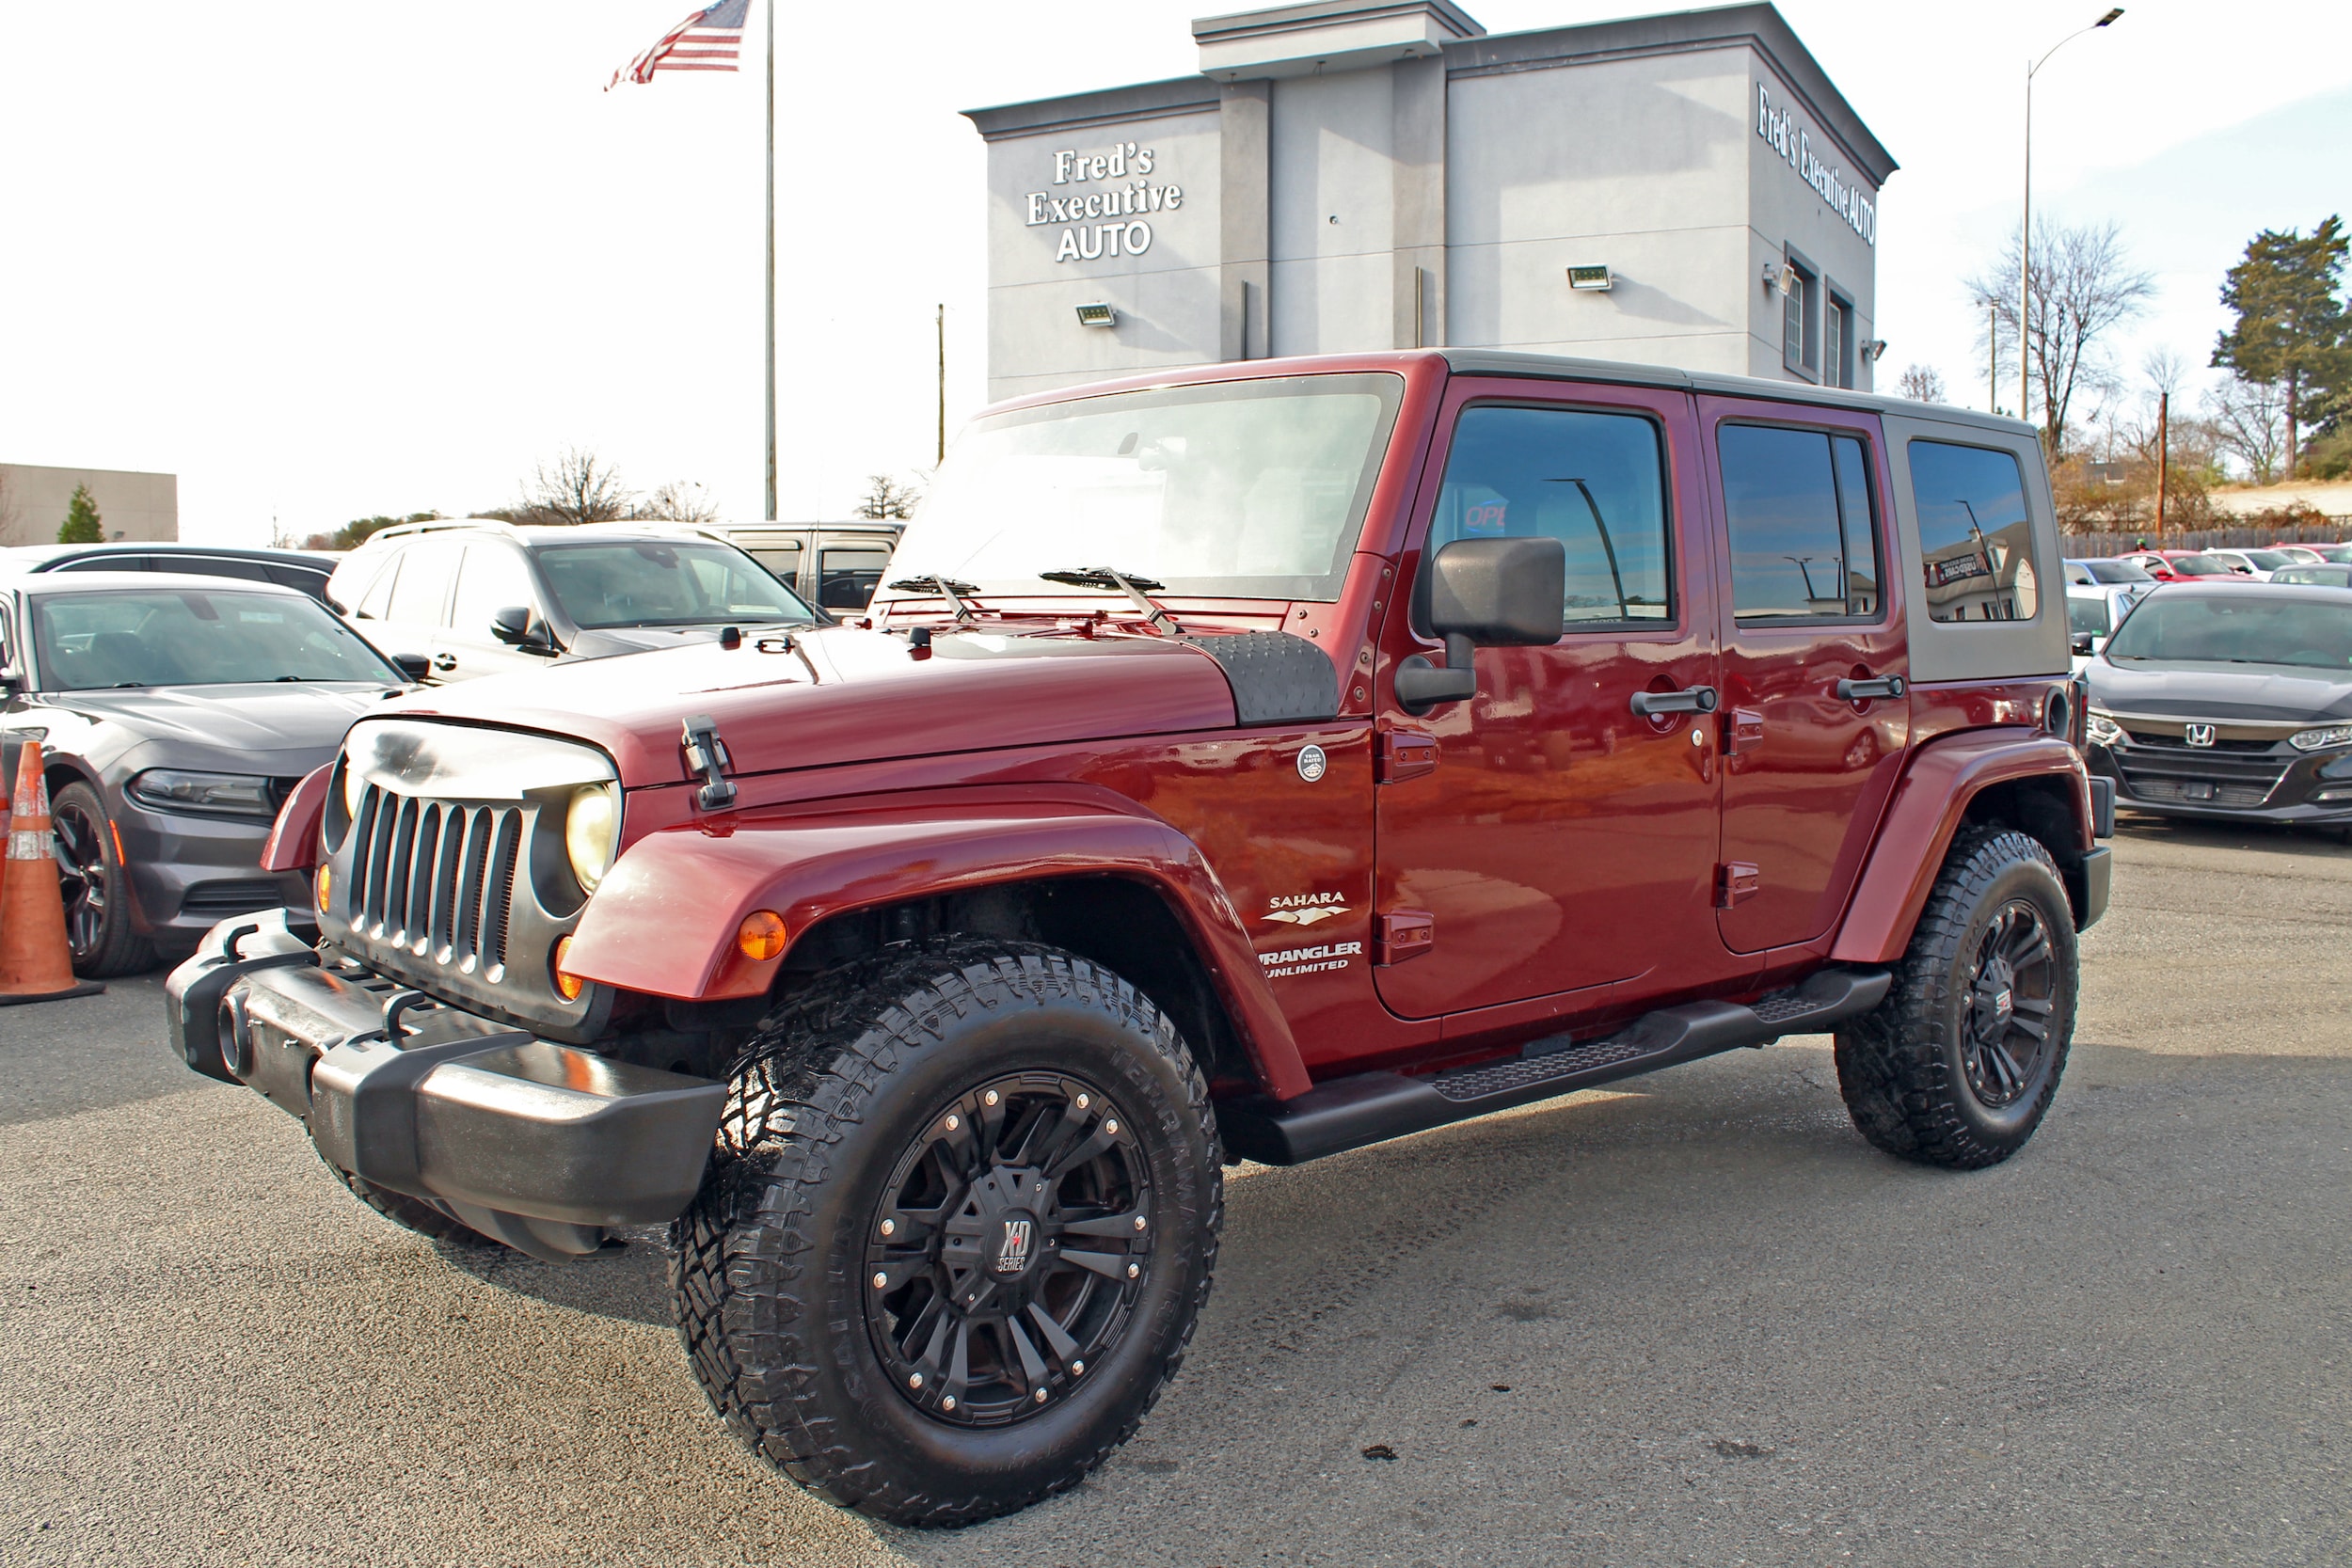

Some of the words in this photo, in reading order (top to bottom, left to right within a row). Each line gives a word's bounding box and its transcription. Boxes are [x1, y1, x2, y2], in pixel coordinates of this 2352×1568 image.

[1053, 141, 1154, 185] Fred's
[1756, 82, 1797, 169] Fred's
[1799, 126, 1849, 220] Executive
[1848, 186, 1875, 246] AUTO
[1025, 179, 1183, 227] Executive
[1056, 219, 1152, 263] AUTO
[1269, 891, 1345, 909] SAHARA
[1265, 959, 1349, 978] UNLIMITED
[1000, 1220, 1031, 1257] XD
[997, 1257, 1025, 1273] SERIES
